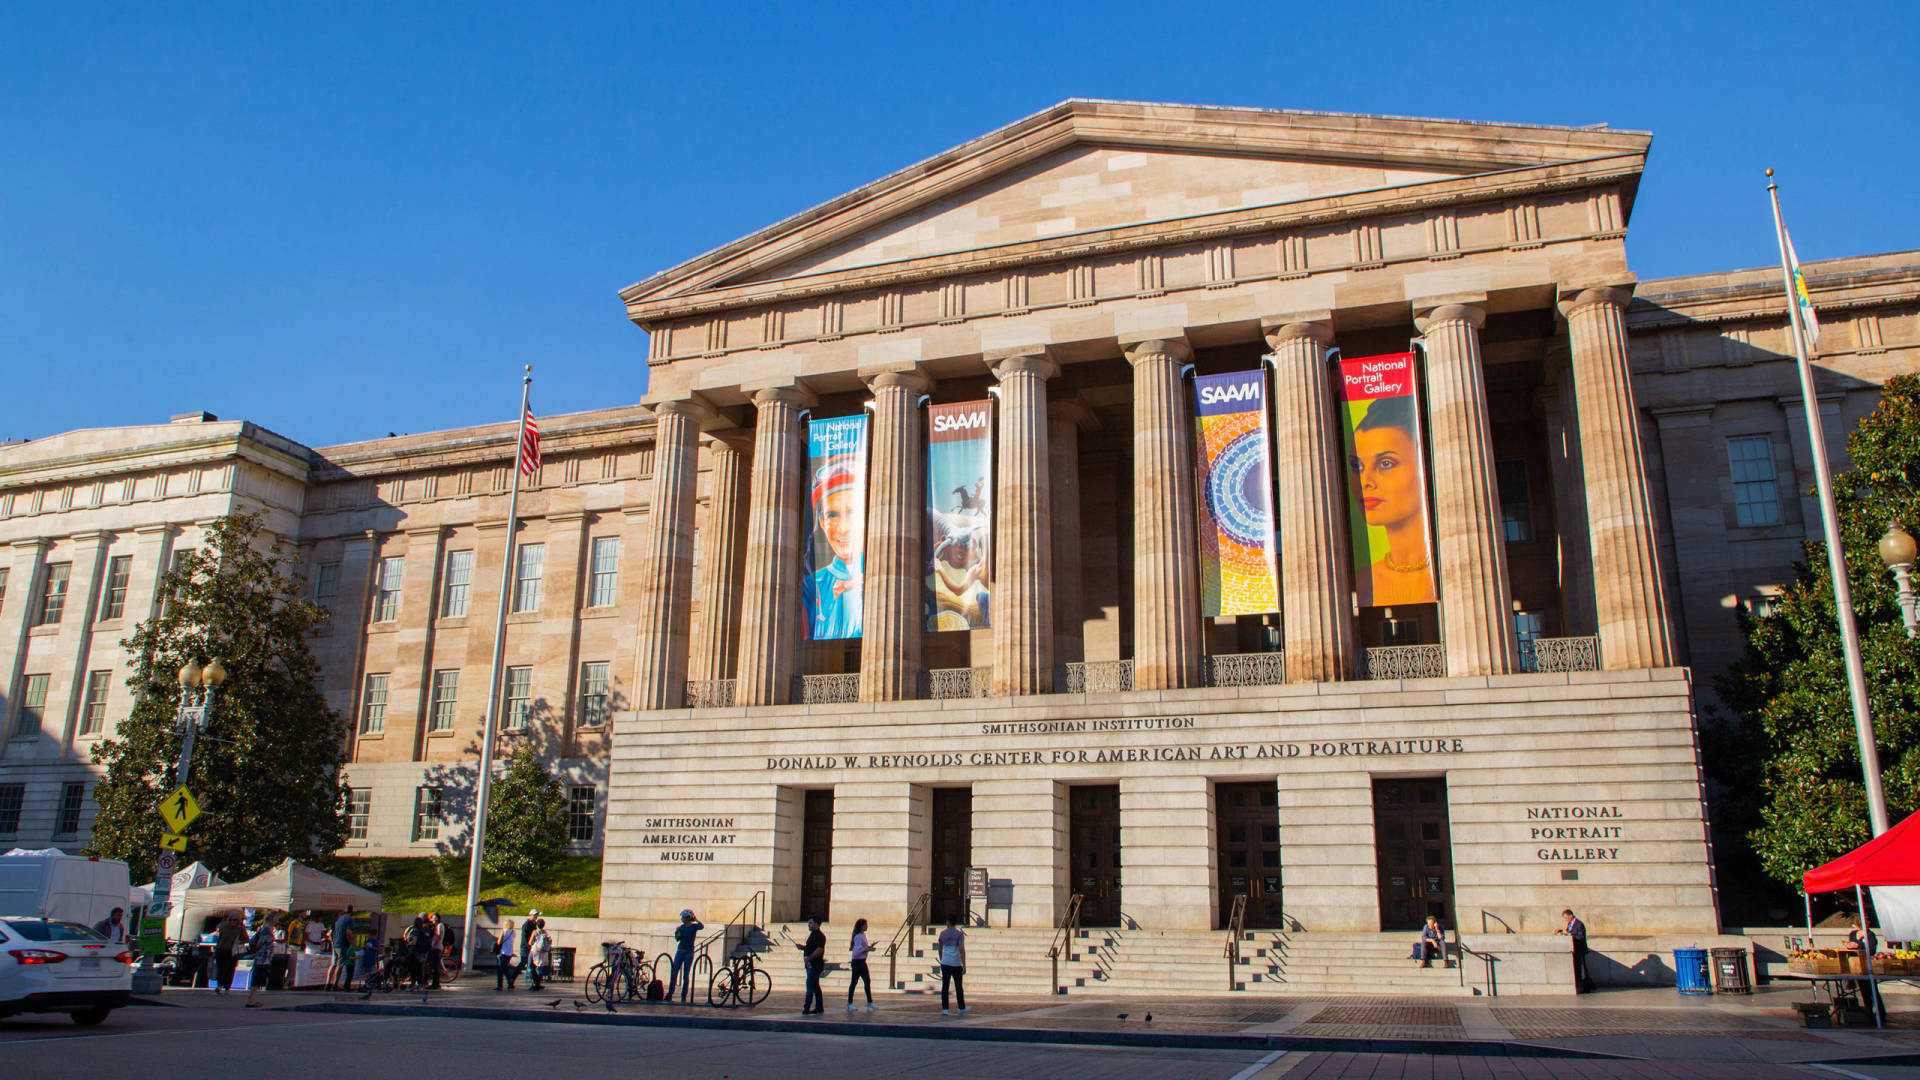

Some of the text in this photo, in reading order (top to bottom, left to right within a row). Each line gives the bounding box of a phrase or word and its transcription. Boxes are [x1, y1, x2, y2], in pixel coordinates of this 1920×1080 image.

[1362, 357, 1407, 373] National
[1345, 372, 1383, 385] Portrait
[1201, 381, 1260, 405] SAAM
[1364, 381, 1403, 394] Gallery
[827, 419, 862, 432] National
[933, 411, 987, 433] SAAM
[813, 430, 843, 442] Portrait
[827, 440, 857, 452] Gallery
[982, 717, 1195, 734] SMITHSONIAN INSTITUTION
[766, 739, 1464, 770] DONALD W. REYNOLDS CENTER FOR AMERICAN ART AND PORTRAITURE
[1526, 806, 1623, 819] NATIONAL
[645, 818, 735, 828] SMITHSONIAN
[642, 834, 737, 844] AMERICAN ART
[1530, 826, 1622, 839] PORTRAIT
[660, 851, 715, 861] MUSEUM
[1537, 848, 1619, 860] GALLERY
